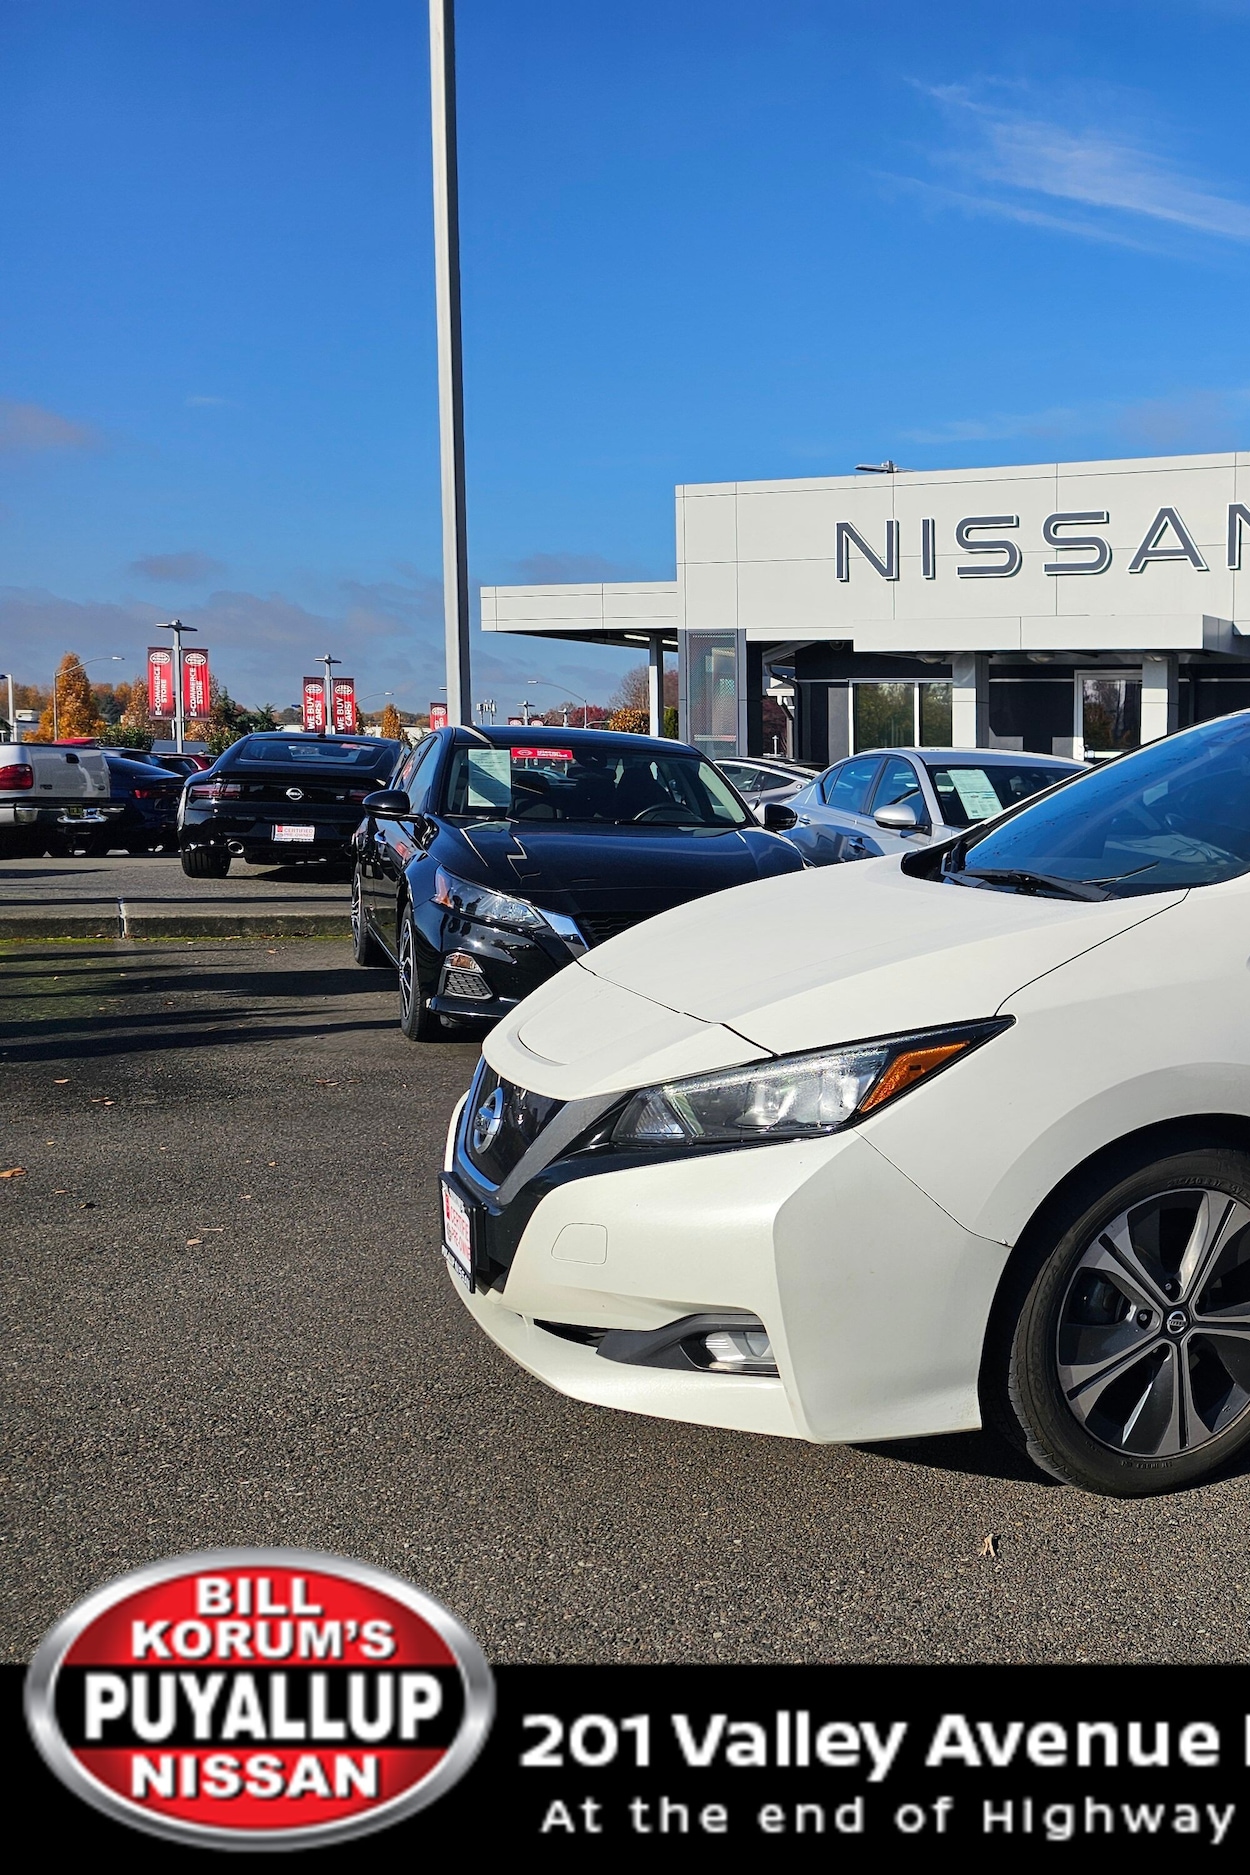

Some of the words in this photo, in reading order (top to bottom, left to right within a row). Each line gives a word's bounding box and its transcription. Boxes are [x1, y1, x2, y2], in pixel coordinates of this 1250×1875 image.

[196, 680, 204, 705] STORE
[306, 696, 315, 715] BUY
[336, 697, 344, 715] BUY
[307, 715, 315, 730] WE
[337, 717, 345, 731] WE
